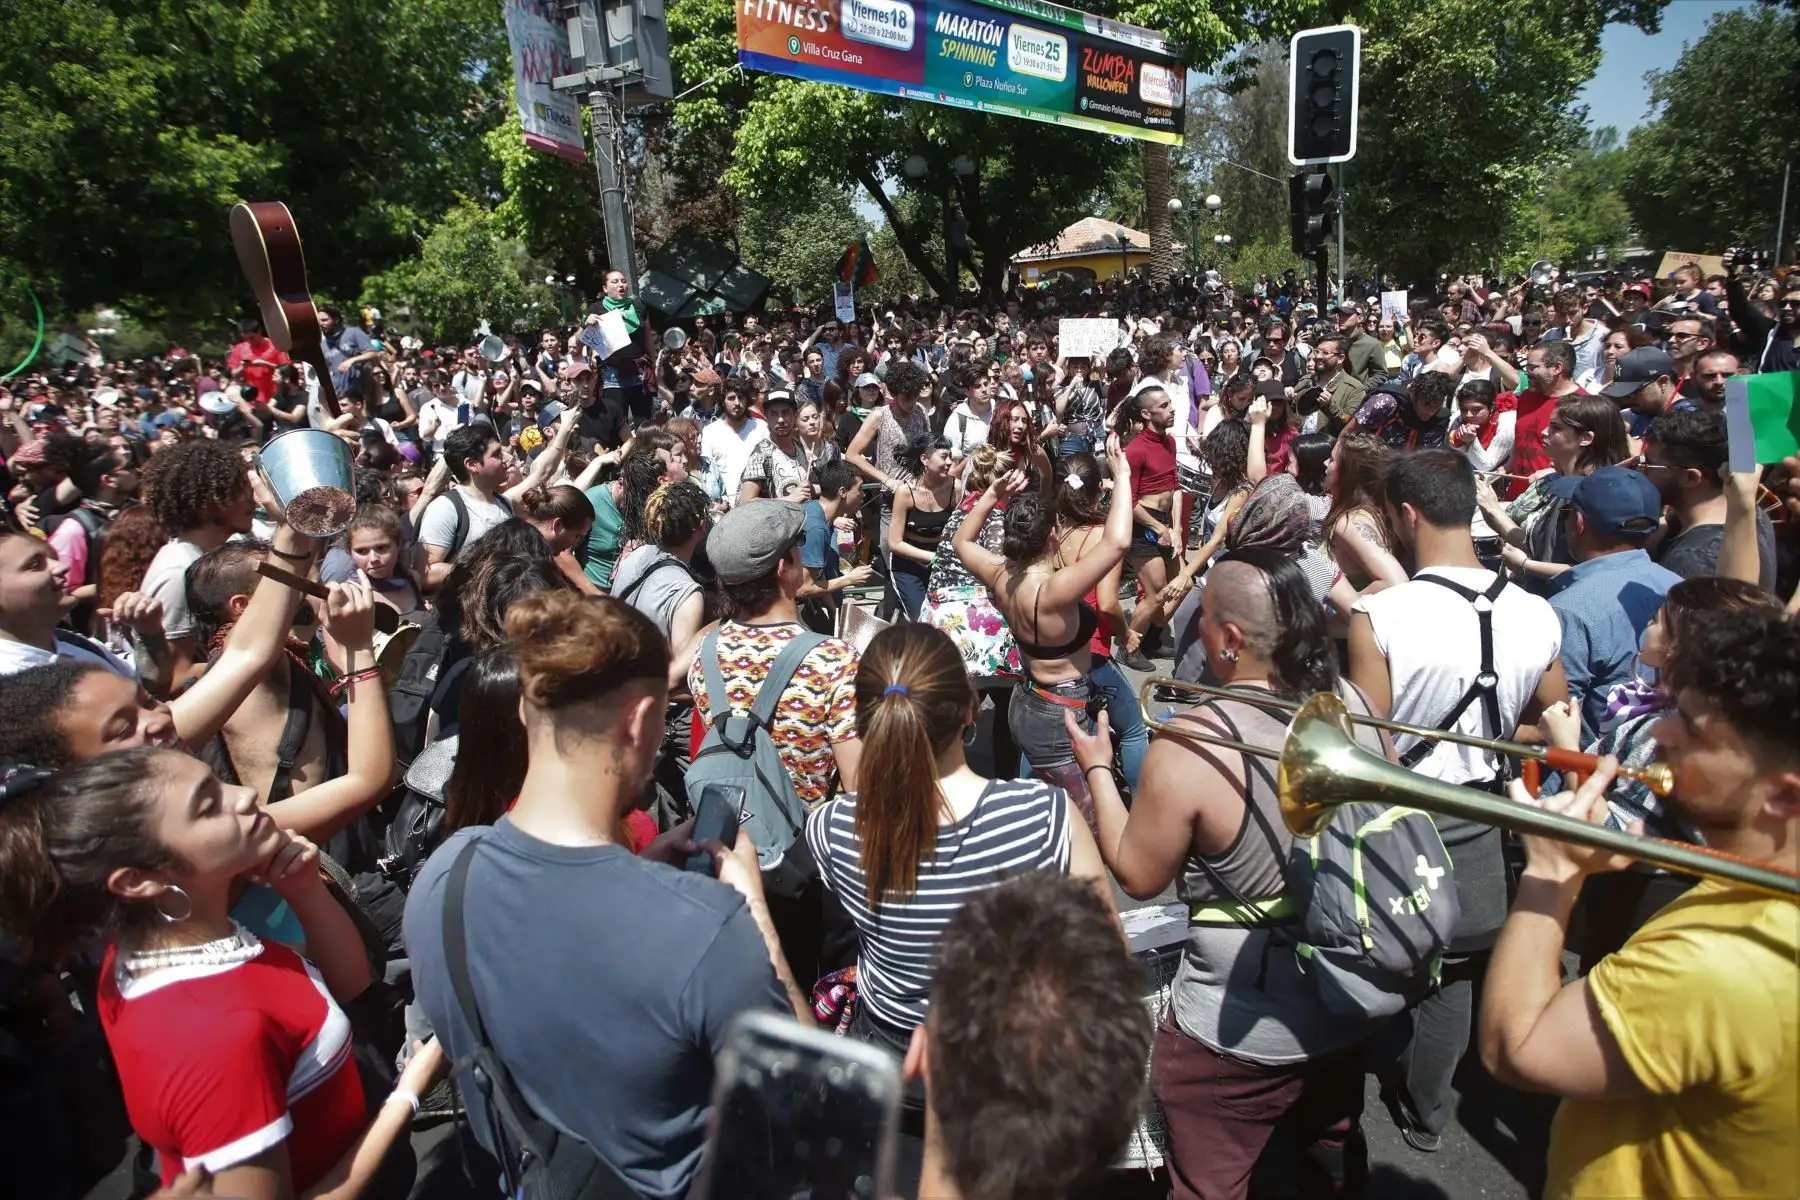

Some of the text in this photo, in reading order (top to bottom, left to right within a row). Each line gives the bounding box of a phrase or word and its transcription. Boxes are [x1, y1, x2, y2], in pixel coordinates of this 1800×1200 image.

[743, 0, 830, 33] FITNESS
[851, 0, 908, 30] Viernes 18
[1040, 2, 1067, 22] 2019
[881, 28, 897, 41] 22:00
[935, 11, 1004, 47] MARATÓN
[802, 41, 863, 65] Villa Cruz Gana
[939, 39, 997, 67] SPINNING
[1014, 34, 1060, 62] Viernes 25
[1083, 47, 1134, 82] ZUMBA
[975, 76, 993, 90] Plaza
[1017, 85, 1028, 96] Sur
[1087, 75, 1128, 95] HALLOWEEN
[1143, 71, 1172, 90] Miércoles
[1170, 78, 1182, 95] 30
[1089, 100, 1142, 119] Gimnasio Polideportivo
